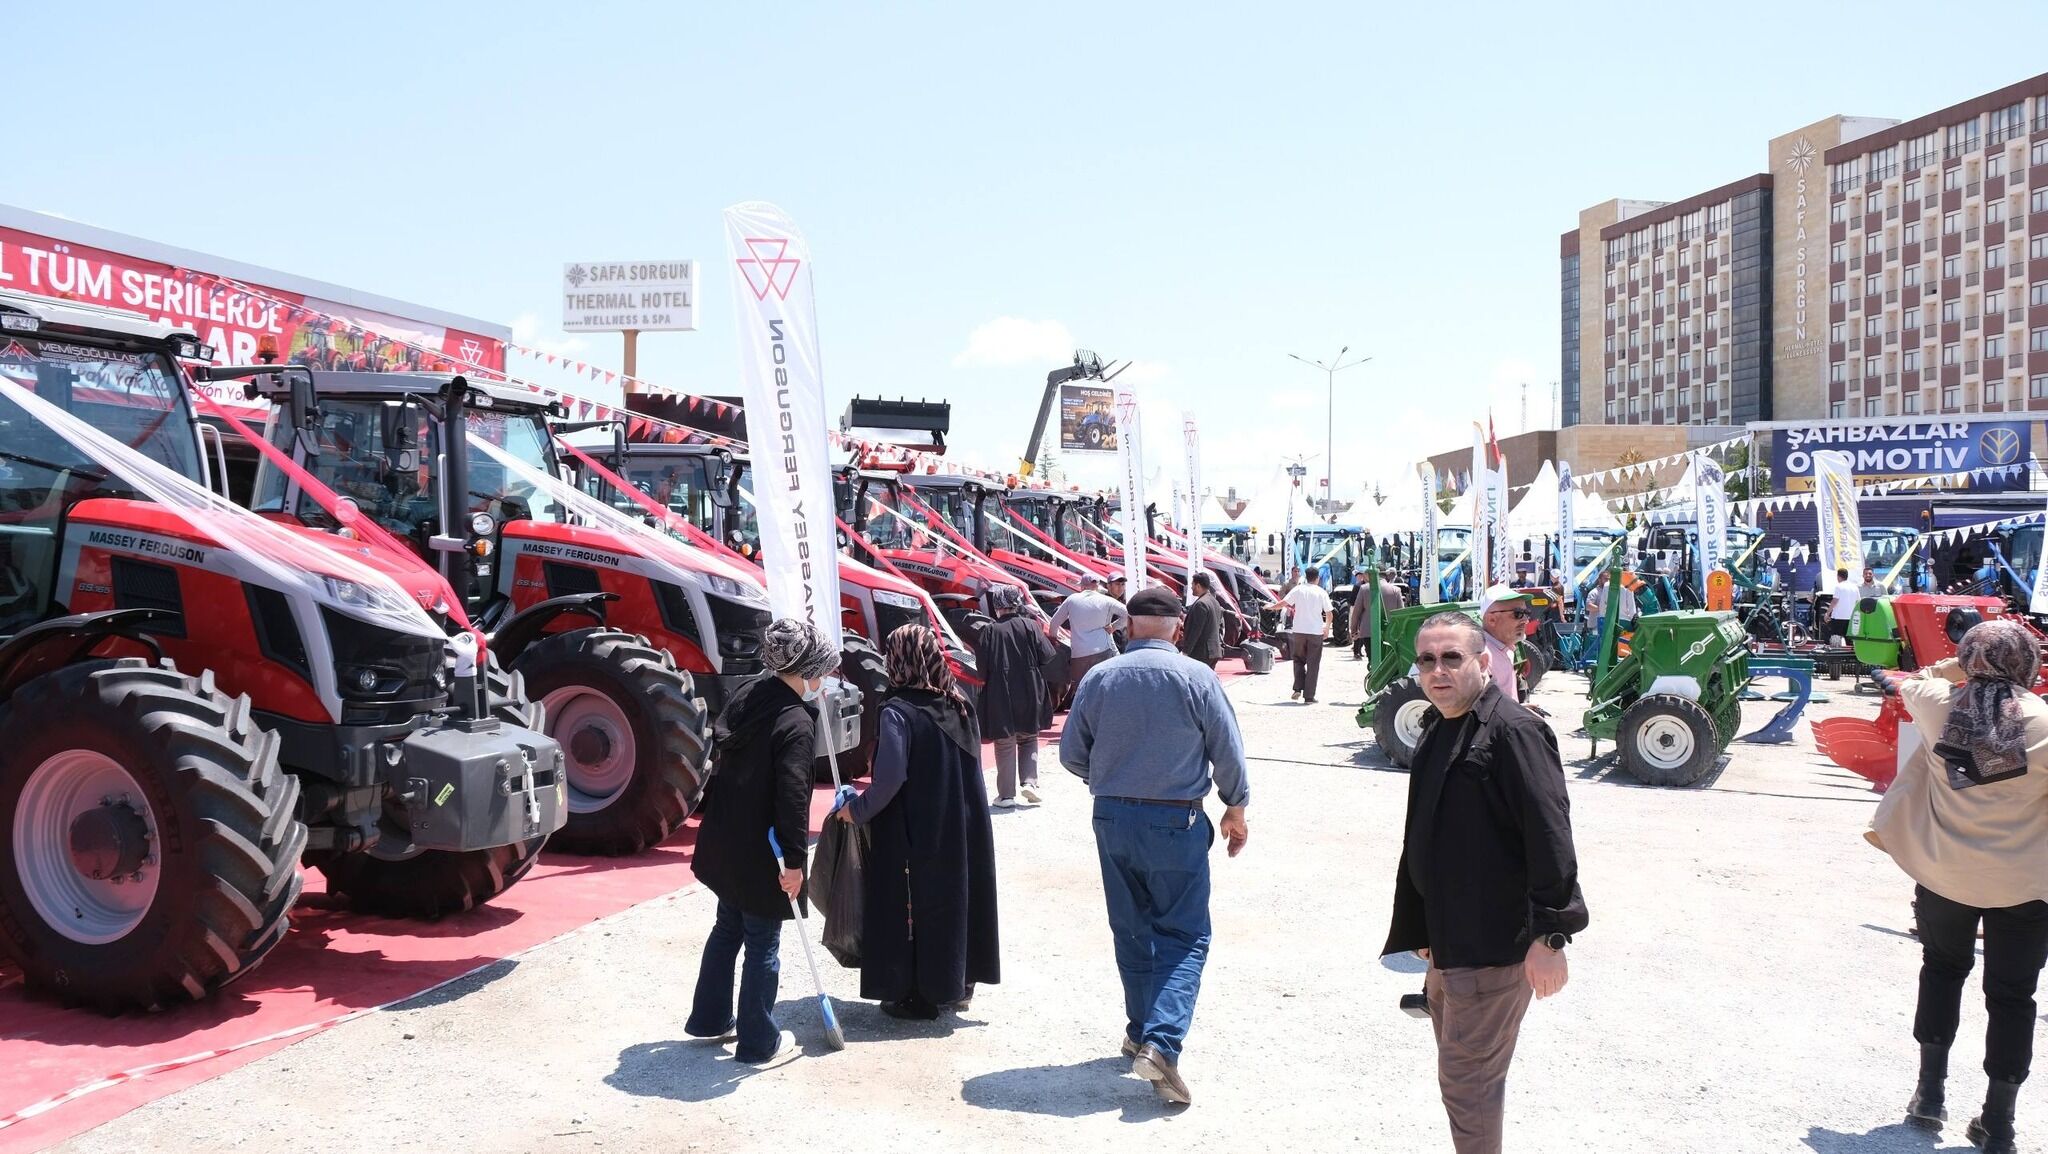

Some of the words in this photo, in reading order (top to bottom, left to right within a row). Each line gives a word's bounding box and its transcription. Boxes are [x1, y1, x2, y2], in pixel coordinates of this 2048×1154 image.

[1796, 179, 1807, 241] SAFA
[22, 243, 112, 301] TÜM
[590, 265, 626, 282] SAFA
[629, 262, 689, 281] SORGUN
[566, 292, 637, 310] THERMAL
[641, 291, 692, 309] HOTEL
[1796, 247, 1807, 341] SORGUN
[583, 314, 639, 326] WELLNESS
[642, 314, 650, 325] &
[652, 314, 672, 325] SPA
[1786, 422, 1969, 450] ŞAHBAZLAR
[1785, 440, 1969, 474] OMOTİV
[1704, 494, 1716, 536] GRUP
[88, 530, 137, 549] MASSEY
[138, 538, 206, 564] FERGUSON
[522, 542, 563, 556] MASSEY
[564, 548, 620, 567] FERGUSON
[1707, 538, 1718, 572] ĞUR
[916, 564, 949, 578] FERGUSON
[1003, 565, 1027, 579] MASSEY
[1027, 573, 1058, 590] FERGUSON
